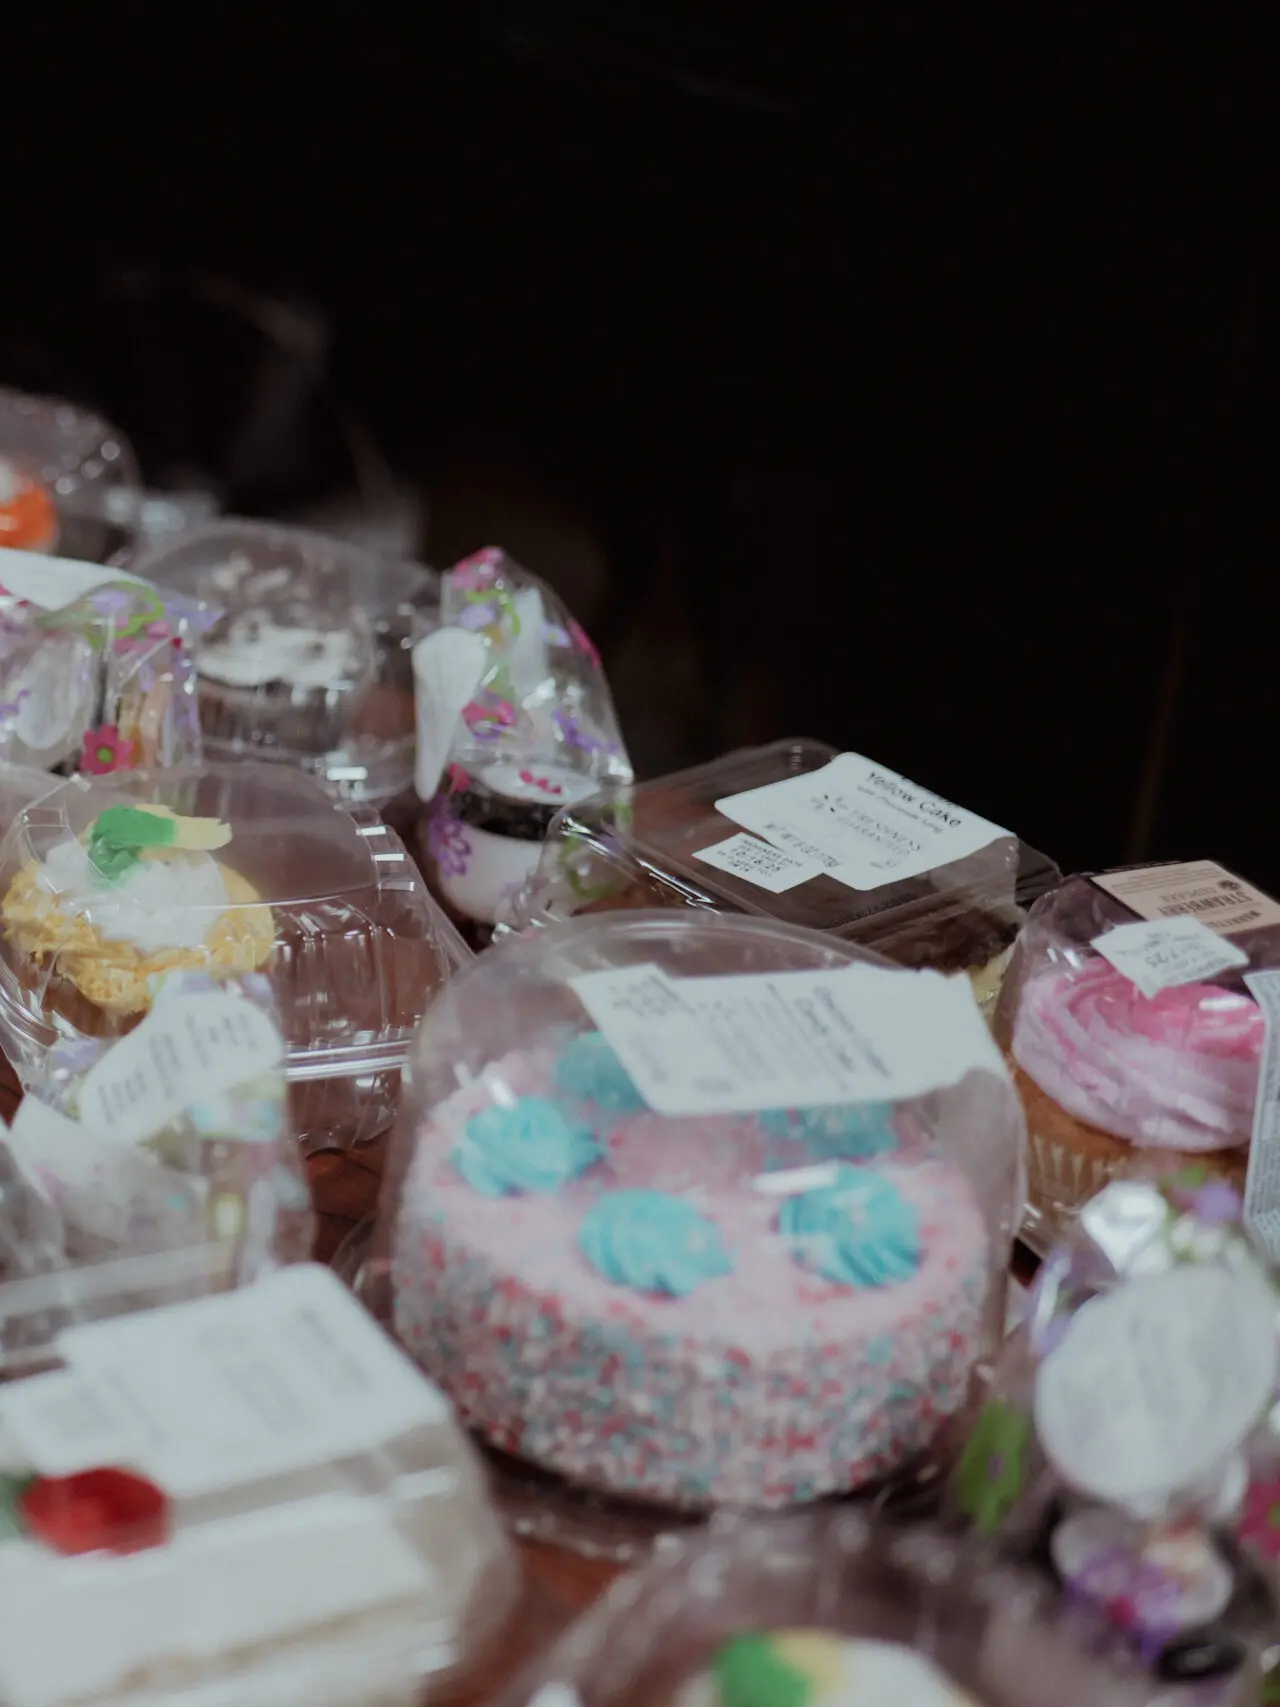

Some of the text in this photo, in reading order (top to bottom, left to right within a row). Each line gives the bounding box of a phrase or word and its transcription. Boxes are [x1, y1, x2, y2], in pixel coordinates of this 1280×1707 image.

[869, 772, 914, 803] Yellow
[919, 801, 962, 828] Cake
[1156, 890, 1252, 917] STRAWBERRY
